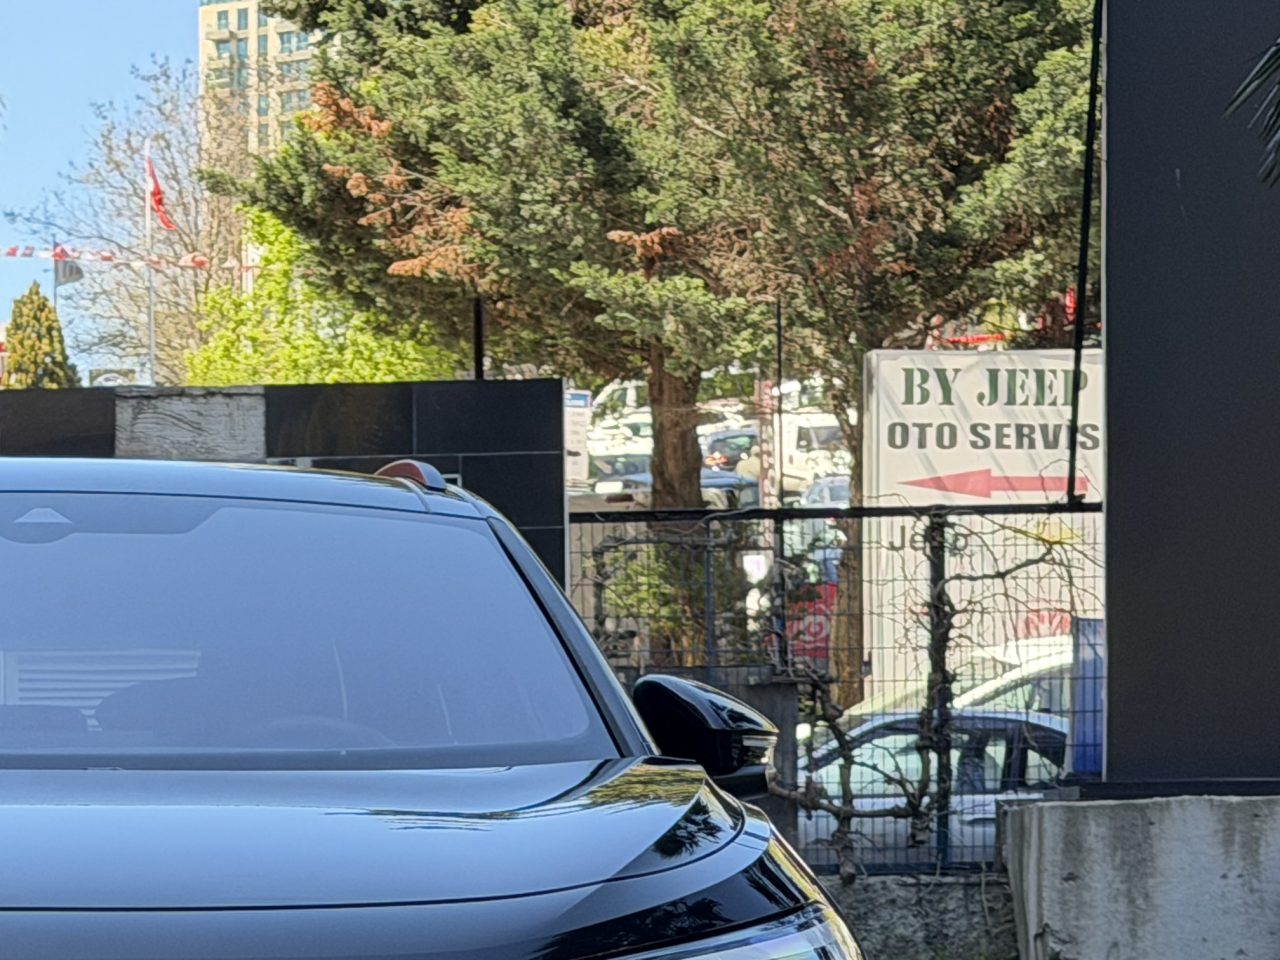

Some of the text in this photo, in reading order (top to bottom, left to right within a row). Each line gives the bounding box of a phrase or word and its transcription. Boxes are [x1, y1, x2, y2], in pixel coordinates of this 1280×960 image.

[901, 368, 1088, 407] BY JEEP
[887, 422, 958, 450] OTO
[889, 525, 968, 556] Jep
